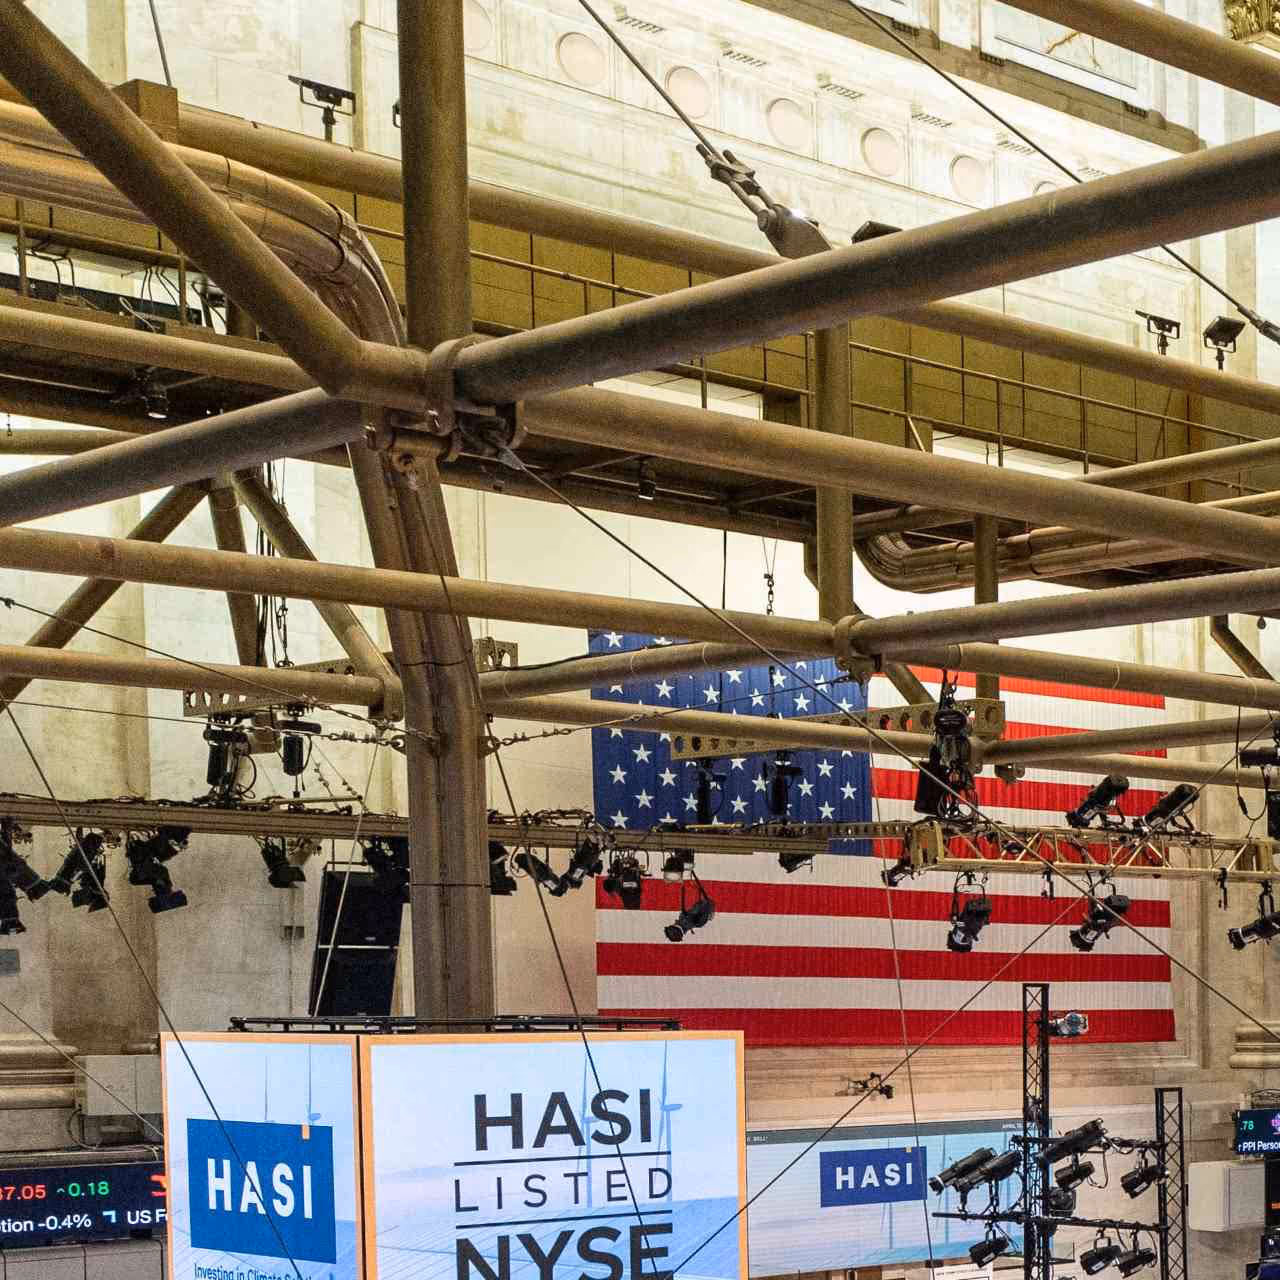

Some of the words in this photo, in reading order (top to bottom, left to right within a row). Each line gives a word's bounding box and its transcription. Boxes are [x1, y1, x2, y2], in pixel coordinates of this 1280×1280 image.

[473, 1088, 653, 1152] HASI
[207, 1158, 313, 1220] HASI
[454, 1165, 674, 1213] LISTED
[835, 1162, 913, 1190] HASI
[37, 1213, 92, 1231] -0.4%
[127, 1209, 151, 1225] US
[236, 1267, 245, 1280] in
